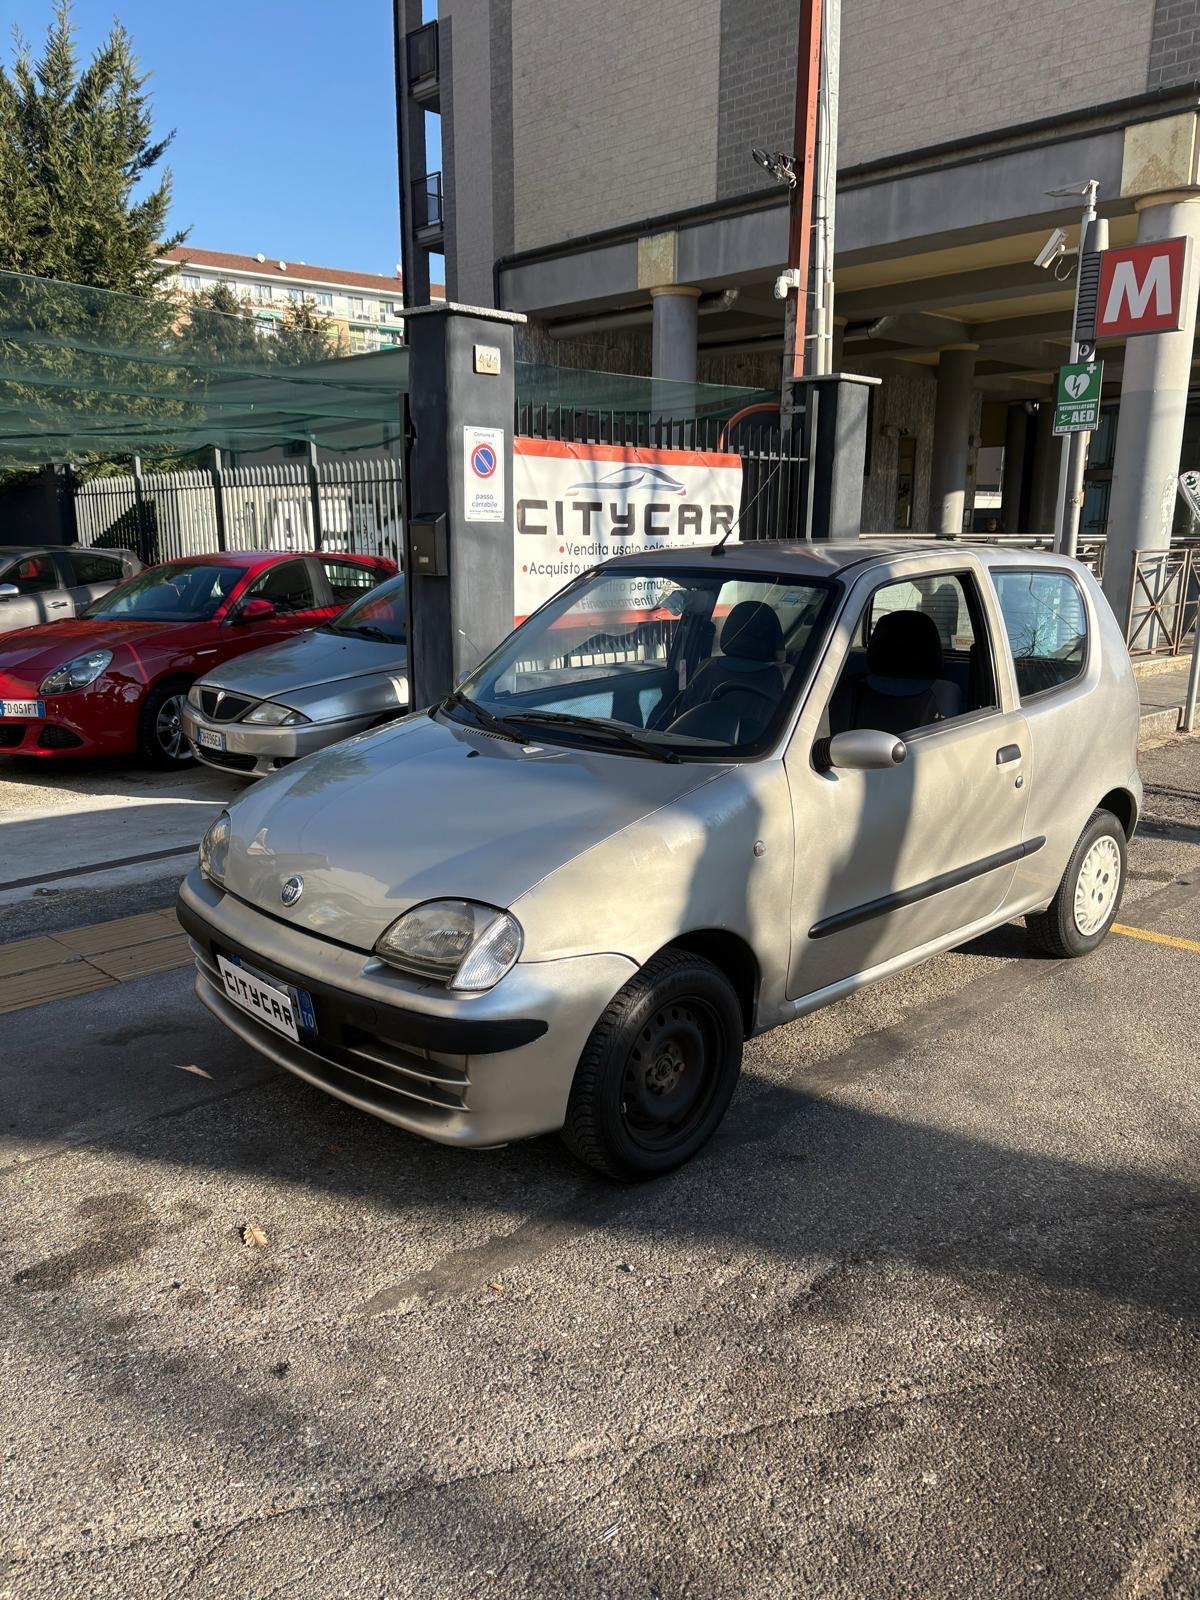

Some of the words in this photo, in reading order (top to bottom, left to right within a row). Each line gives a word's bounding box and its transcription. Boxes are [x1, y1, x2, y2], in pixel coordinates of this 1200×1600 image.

[1103, 255, 1172, 324] M
[1071, 410, 1095, 423] AED
[475, 493, 494, 501] passo
[517, 499, 734, 536] CITYCAR
[566, 542, 609, 557] Vendita
[612, 542, 641, 556] usato
[529, 561, 580, 577] Acquisto
[224, 970, 295, 1030] CITYCAR
[303, 1010, 315, 1028] TO
